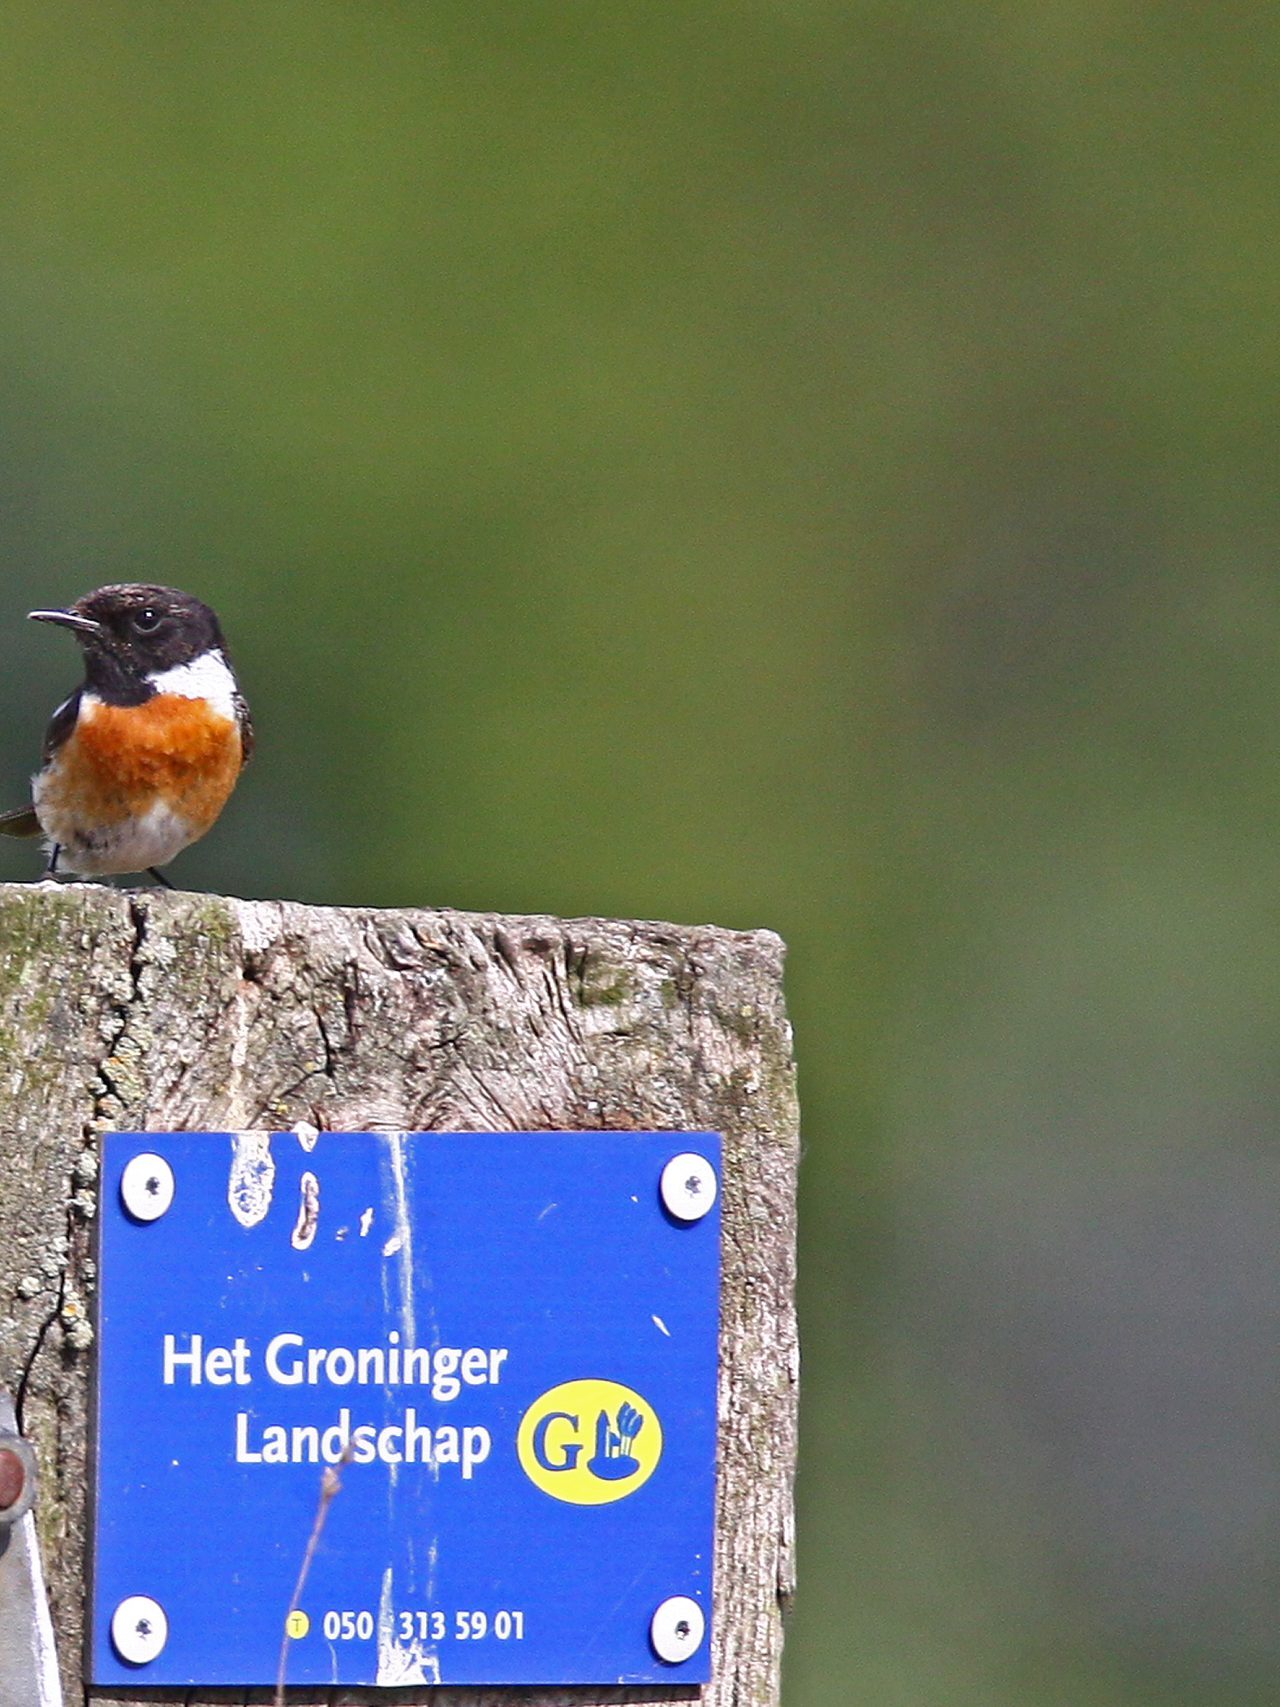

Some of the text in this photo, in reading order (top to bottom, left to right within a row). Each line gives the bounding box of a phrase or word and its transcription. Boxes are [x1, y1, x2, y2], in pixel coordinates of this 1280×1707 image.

[162, 1330, 510, 1403] Het Groninger
[234, 1407, 493, 1481] Landschap
[322, 1610, 375, 1641] 050
[398, 1610, 447, 1641] 313
[454, 1610, 488, 1641] 59
[493, 1610, 525, 1641] 01
